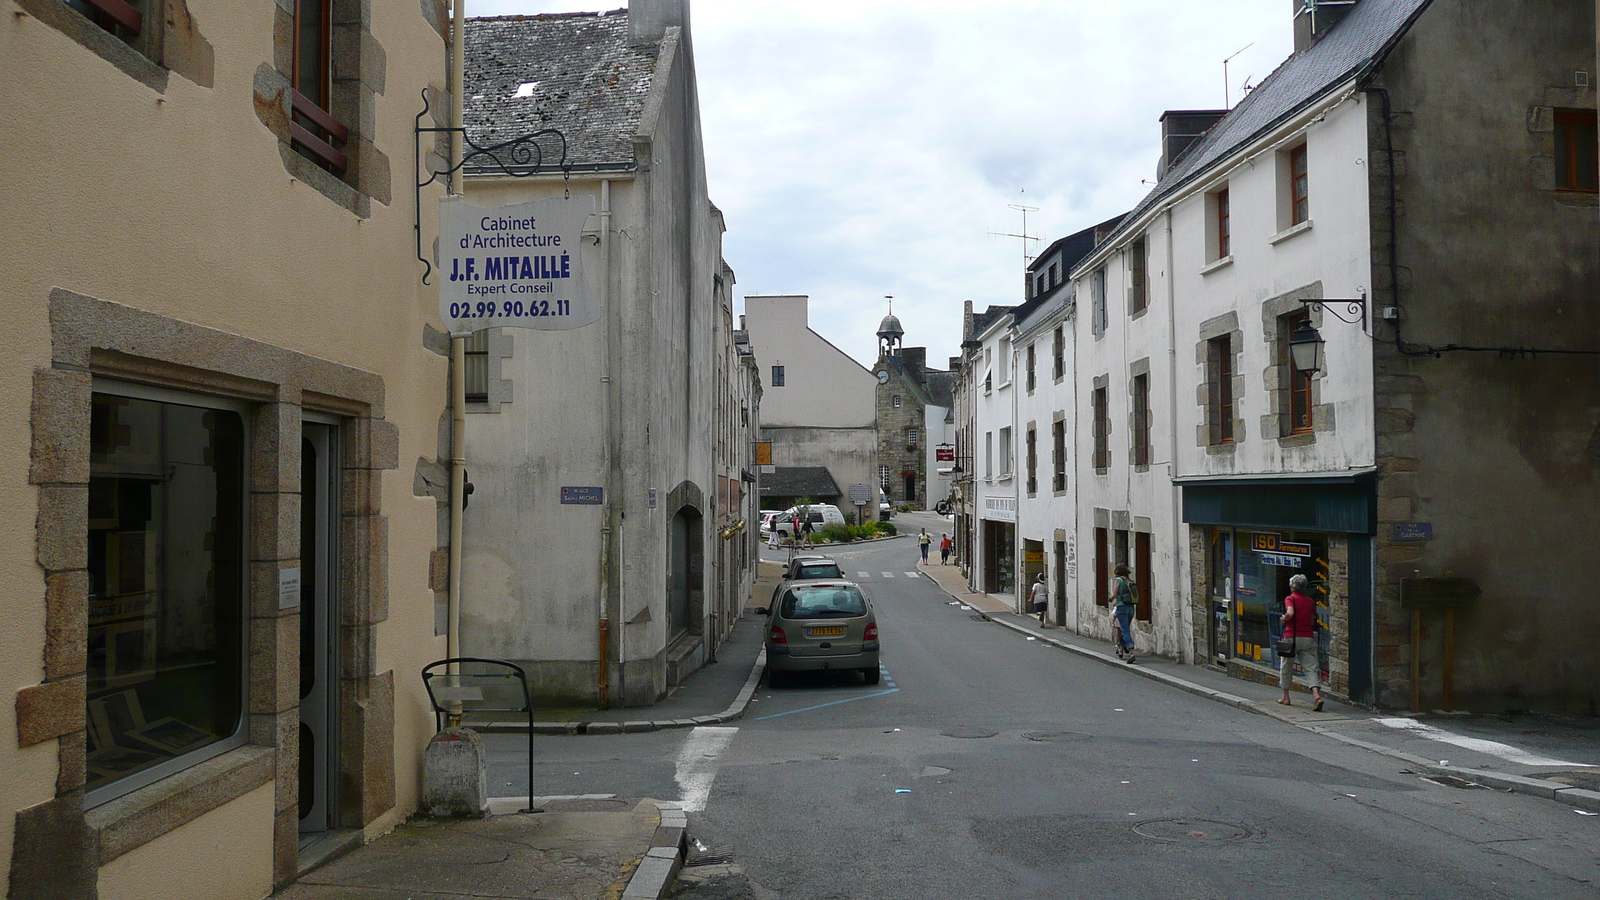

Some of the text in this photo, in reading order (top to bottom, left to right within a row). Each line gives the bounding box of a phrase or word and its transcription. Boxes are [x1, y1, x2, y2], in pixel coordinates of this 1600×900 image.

[480, 215, 536, 231] Cabinet
[460, 233, 561, 249] d'Architecture
[450, 249, 570, 282] J.F. MITAILLÉ
[467, 282, 553, 296] Expert Conseil
[449, 299, 570, 319] 02.99.90.62.11
[1255, 535, 1276, 550] ISO
[1279, 544, 1308, 554] Fermetures
